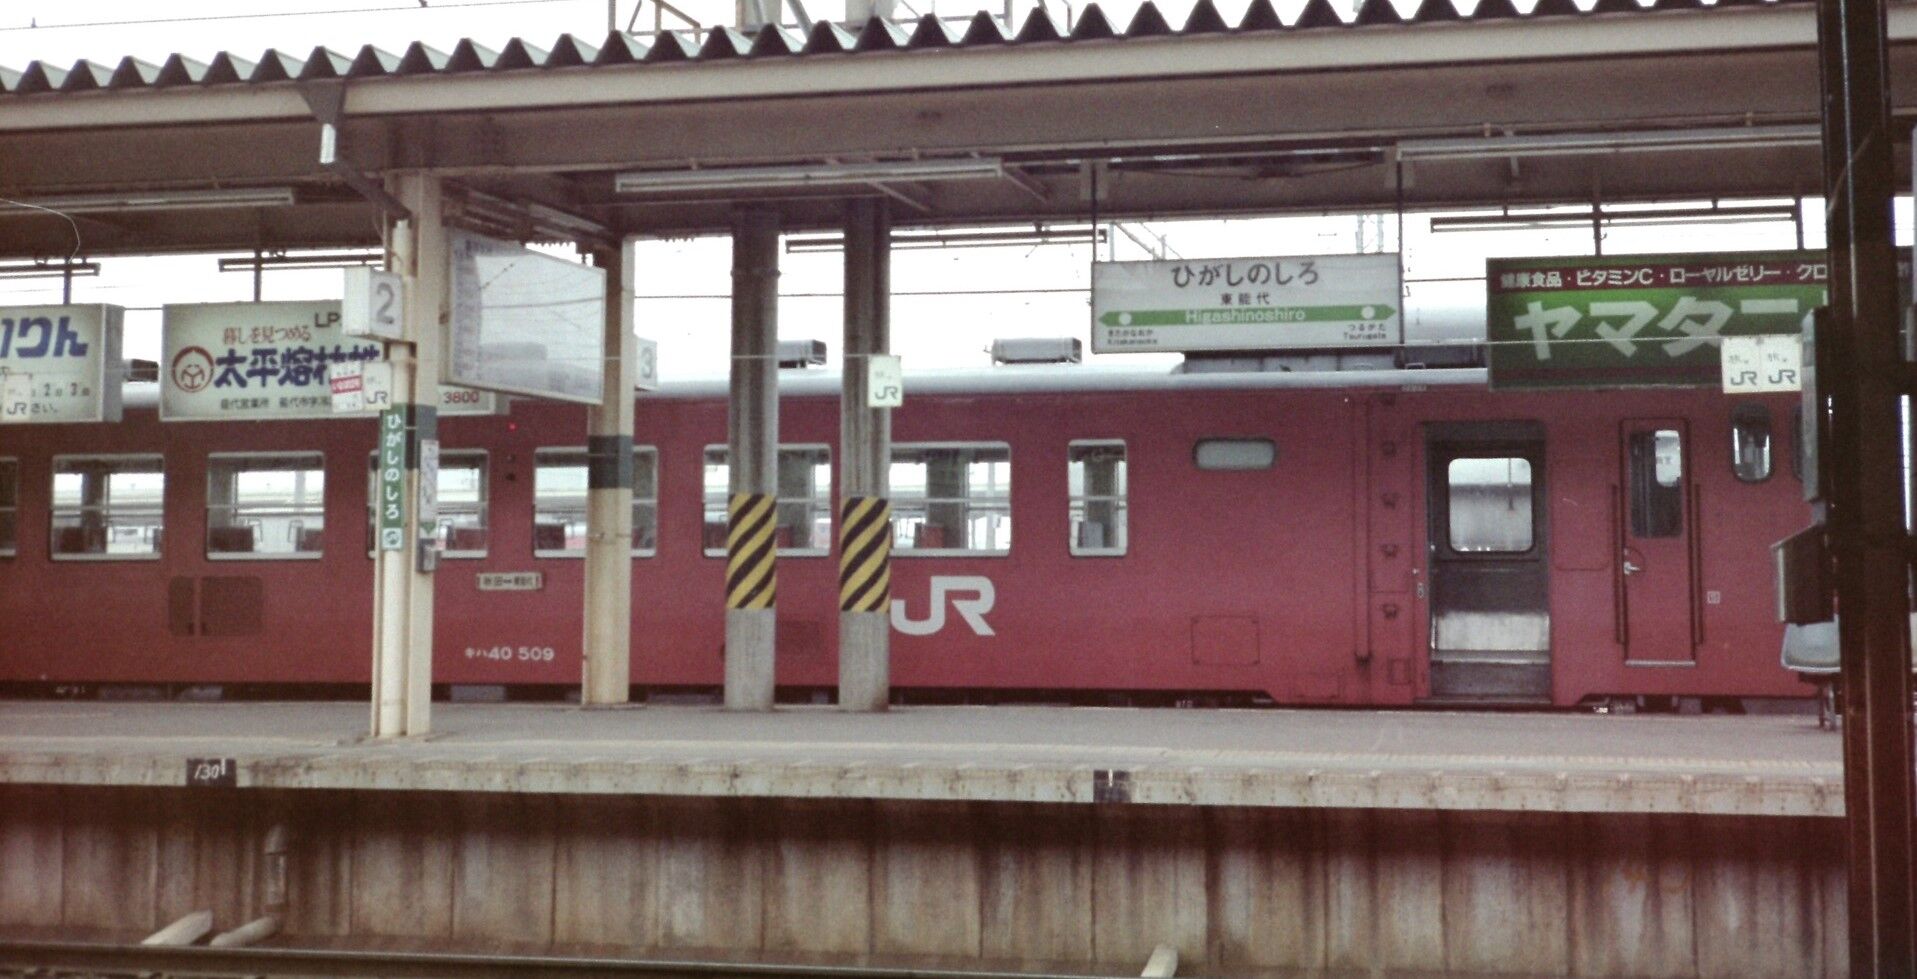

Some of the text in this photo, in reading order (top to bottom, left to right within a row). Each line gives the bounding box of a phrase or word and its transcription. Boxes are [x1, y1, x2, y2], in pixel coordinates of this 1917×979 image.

[1171, 261, 1319, 288] ひがしのしろ
[376, 282, 394, 325] 2
[1220, 292, 1271, 305] 東能代
[1185, 308, 1307, 324] Higashinoshiro
[1730, 370, 1758, 386] JR
[1768, 369, 1797, 384] JR
[366, 390, 389, 405] JR
[443, 390, 480, 404] 3800
[874, 385, 899, 401] JR
[6, 402, 28, 415] JR
[385, 412, 402, 520] ひがしのしろ
[890, 575, 996, 636] JR
[518, 647, 555, 661] 509
